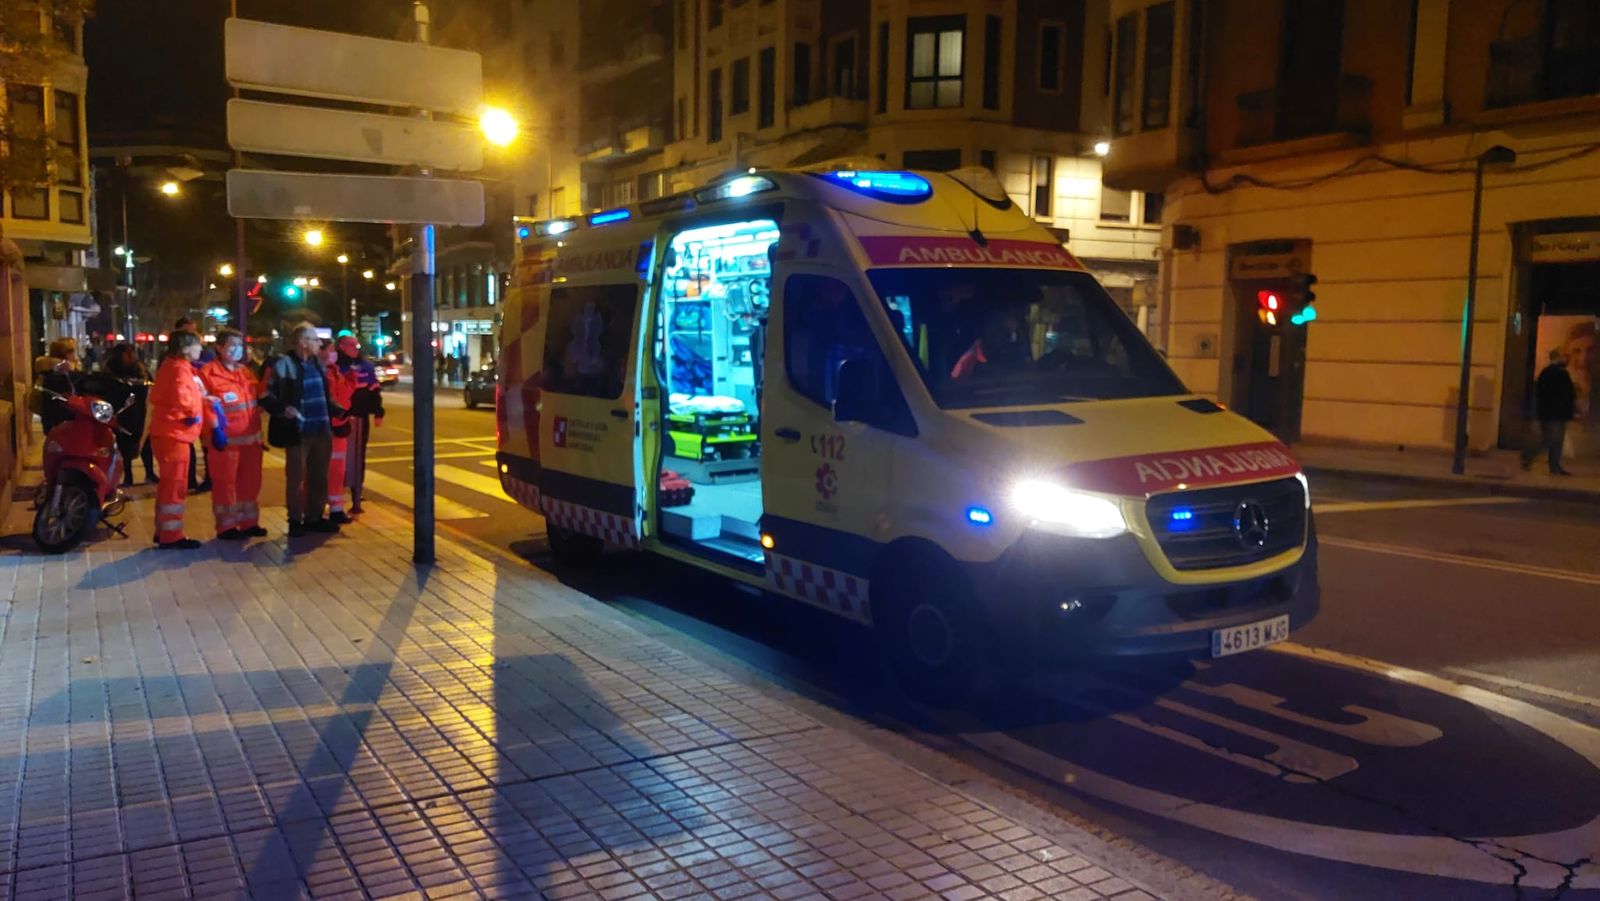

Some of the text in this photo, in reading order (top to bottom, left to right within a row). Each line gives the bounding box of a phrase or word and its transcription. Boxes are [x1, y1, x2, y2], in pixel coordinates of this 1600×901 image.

[898, 245, 1071, 267] AMBULANCIA
[819, 432, 846, 461] 112
[1223, 627, 1260, 651] 4613
